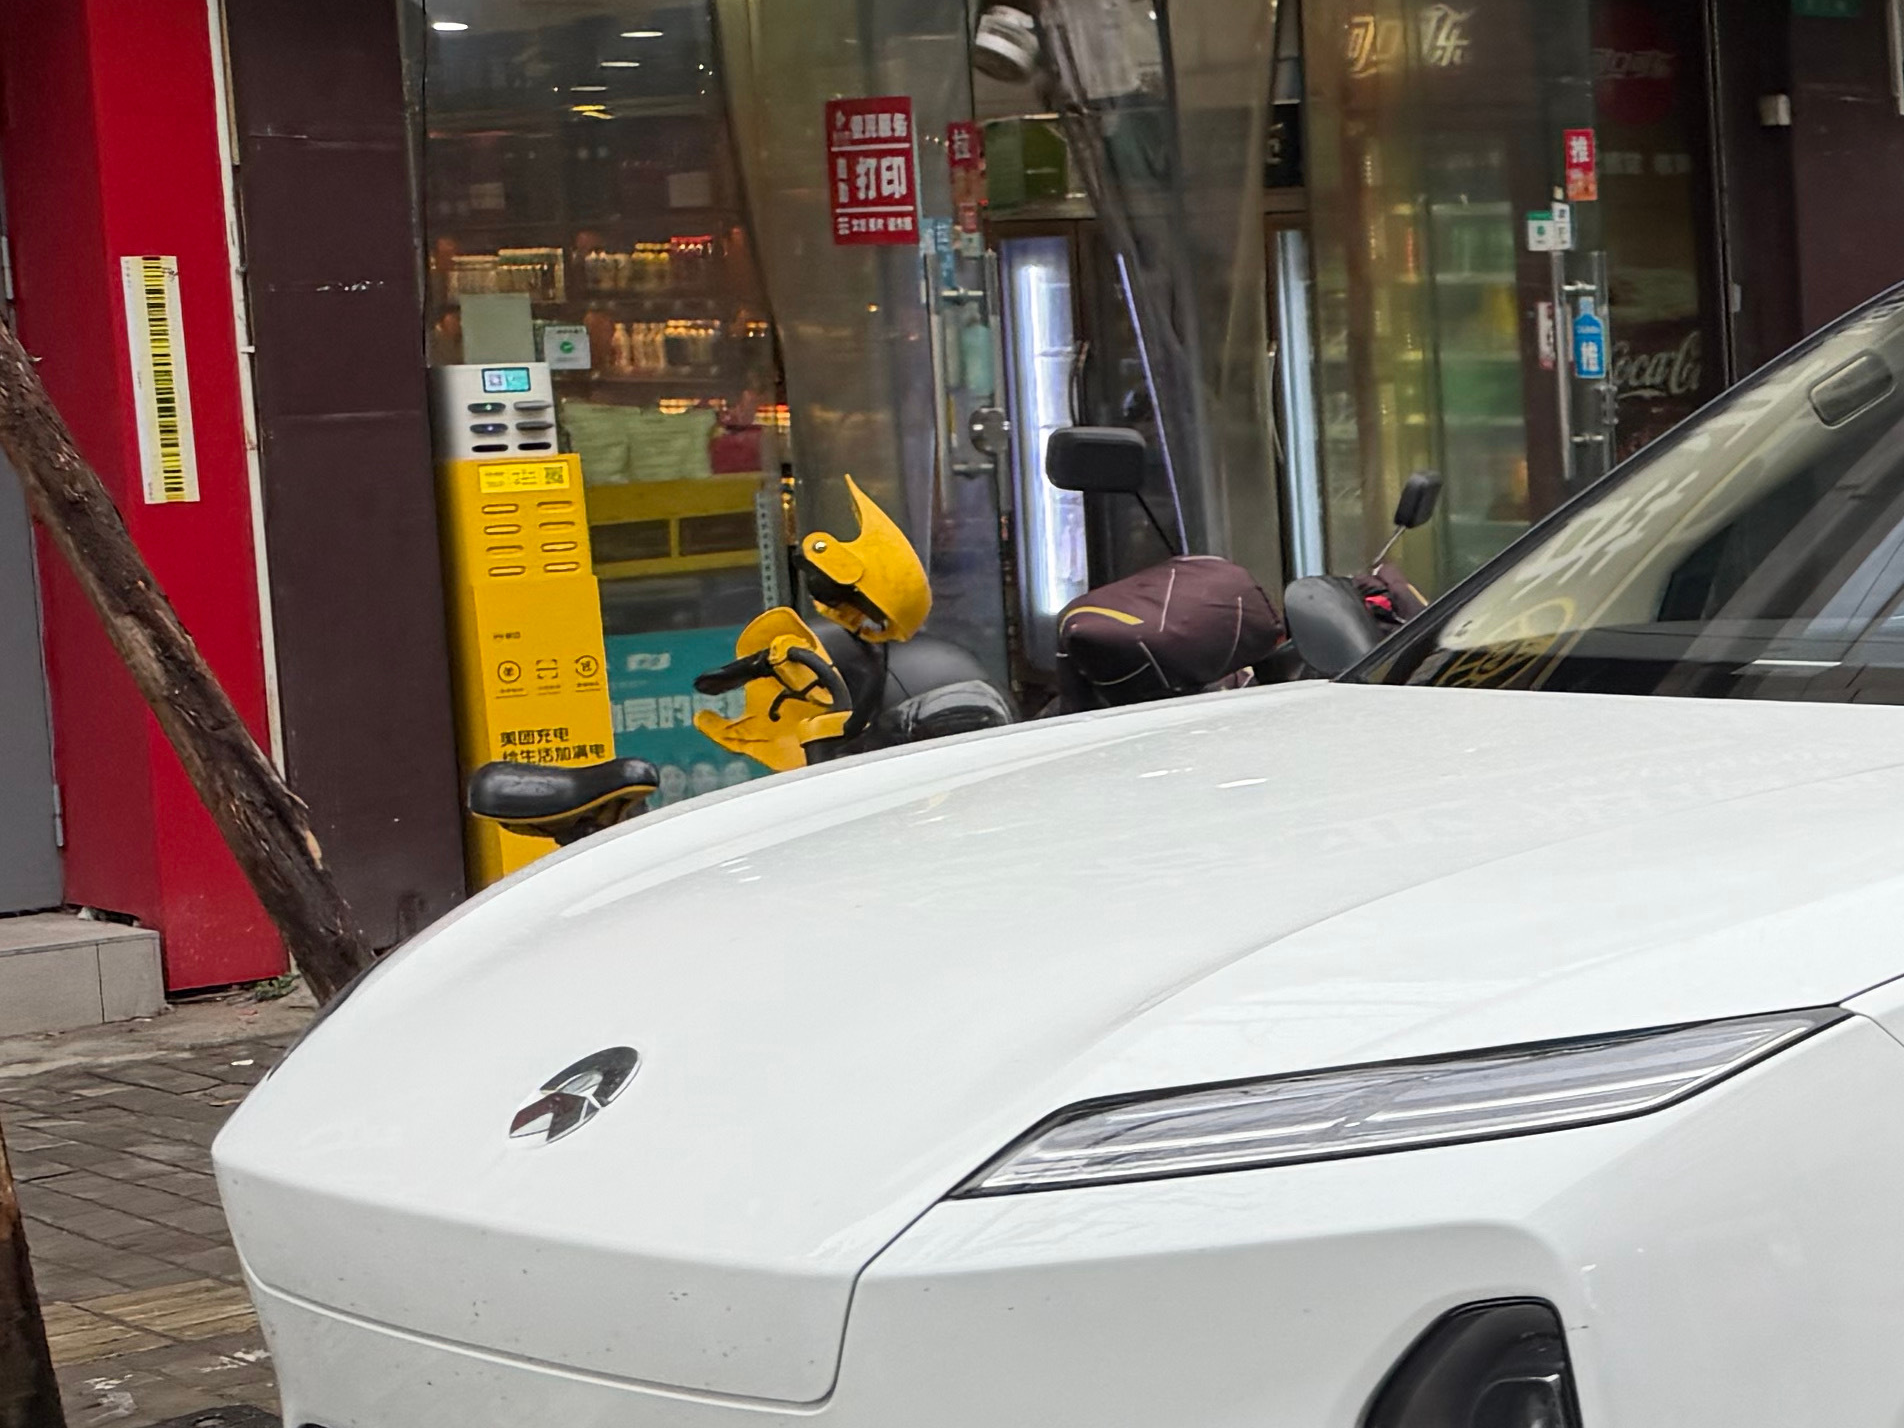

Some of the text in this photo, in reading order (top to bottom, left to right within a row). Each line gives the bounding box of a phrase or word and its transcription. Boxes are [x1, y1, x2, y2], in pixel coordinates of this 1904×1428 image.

[856, 156, 908, 201] 打印
[500, 727, 569, 748] 美团充电
